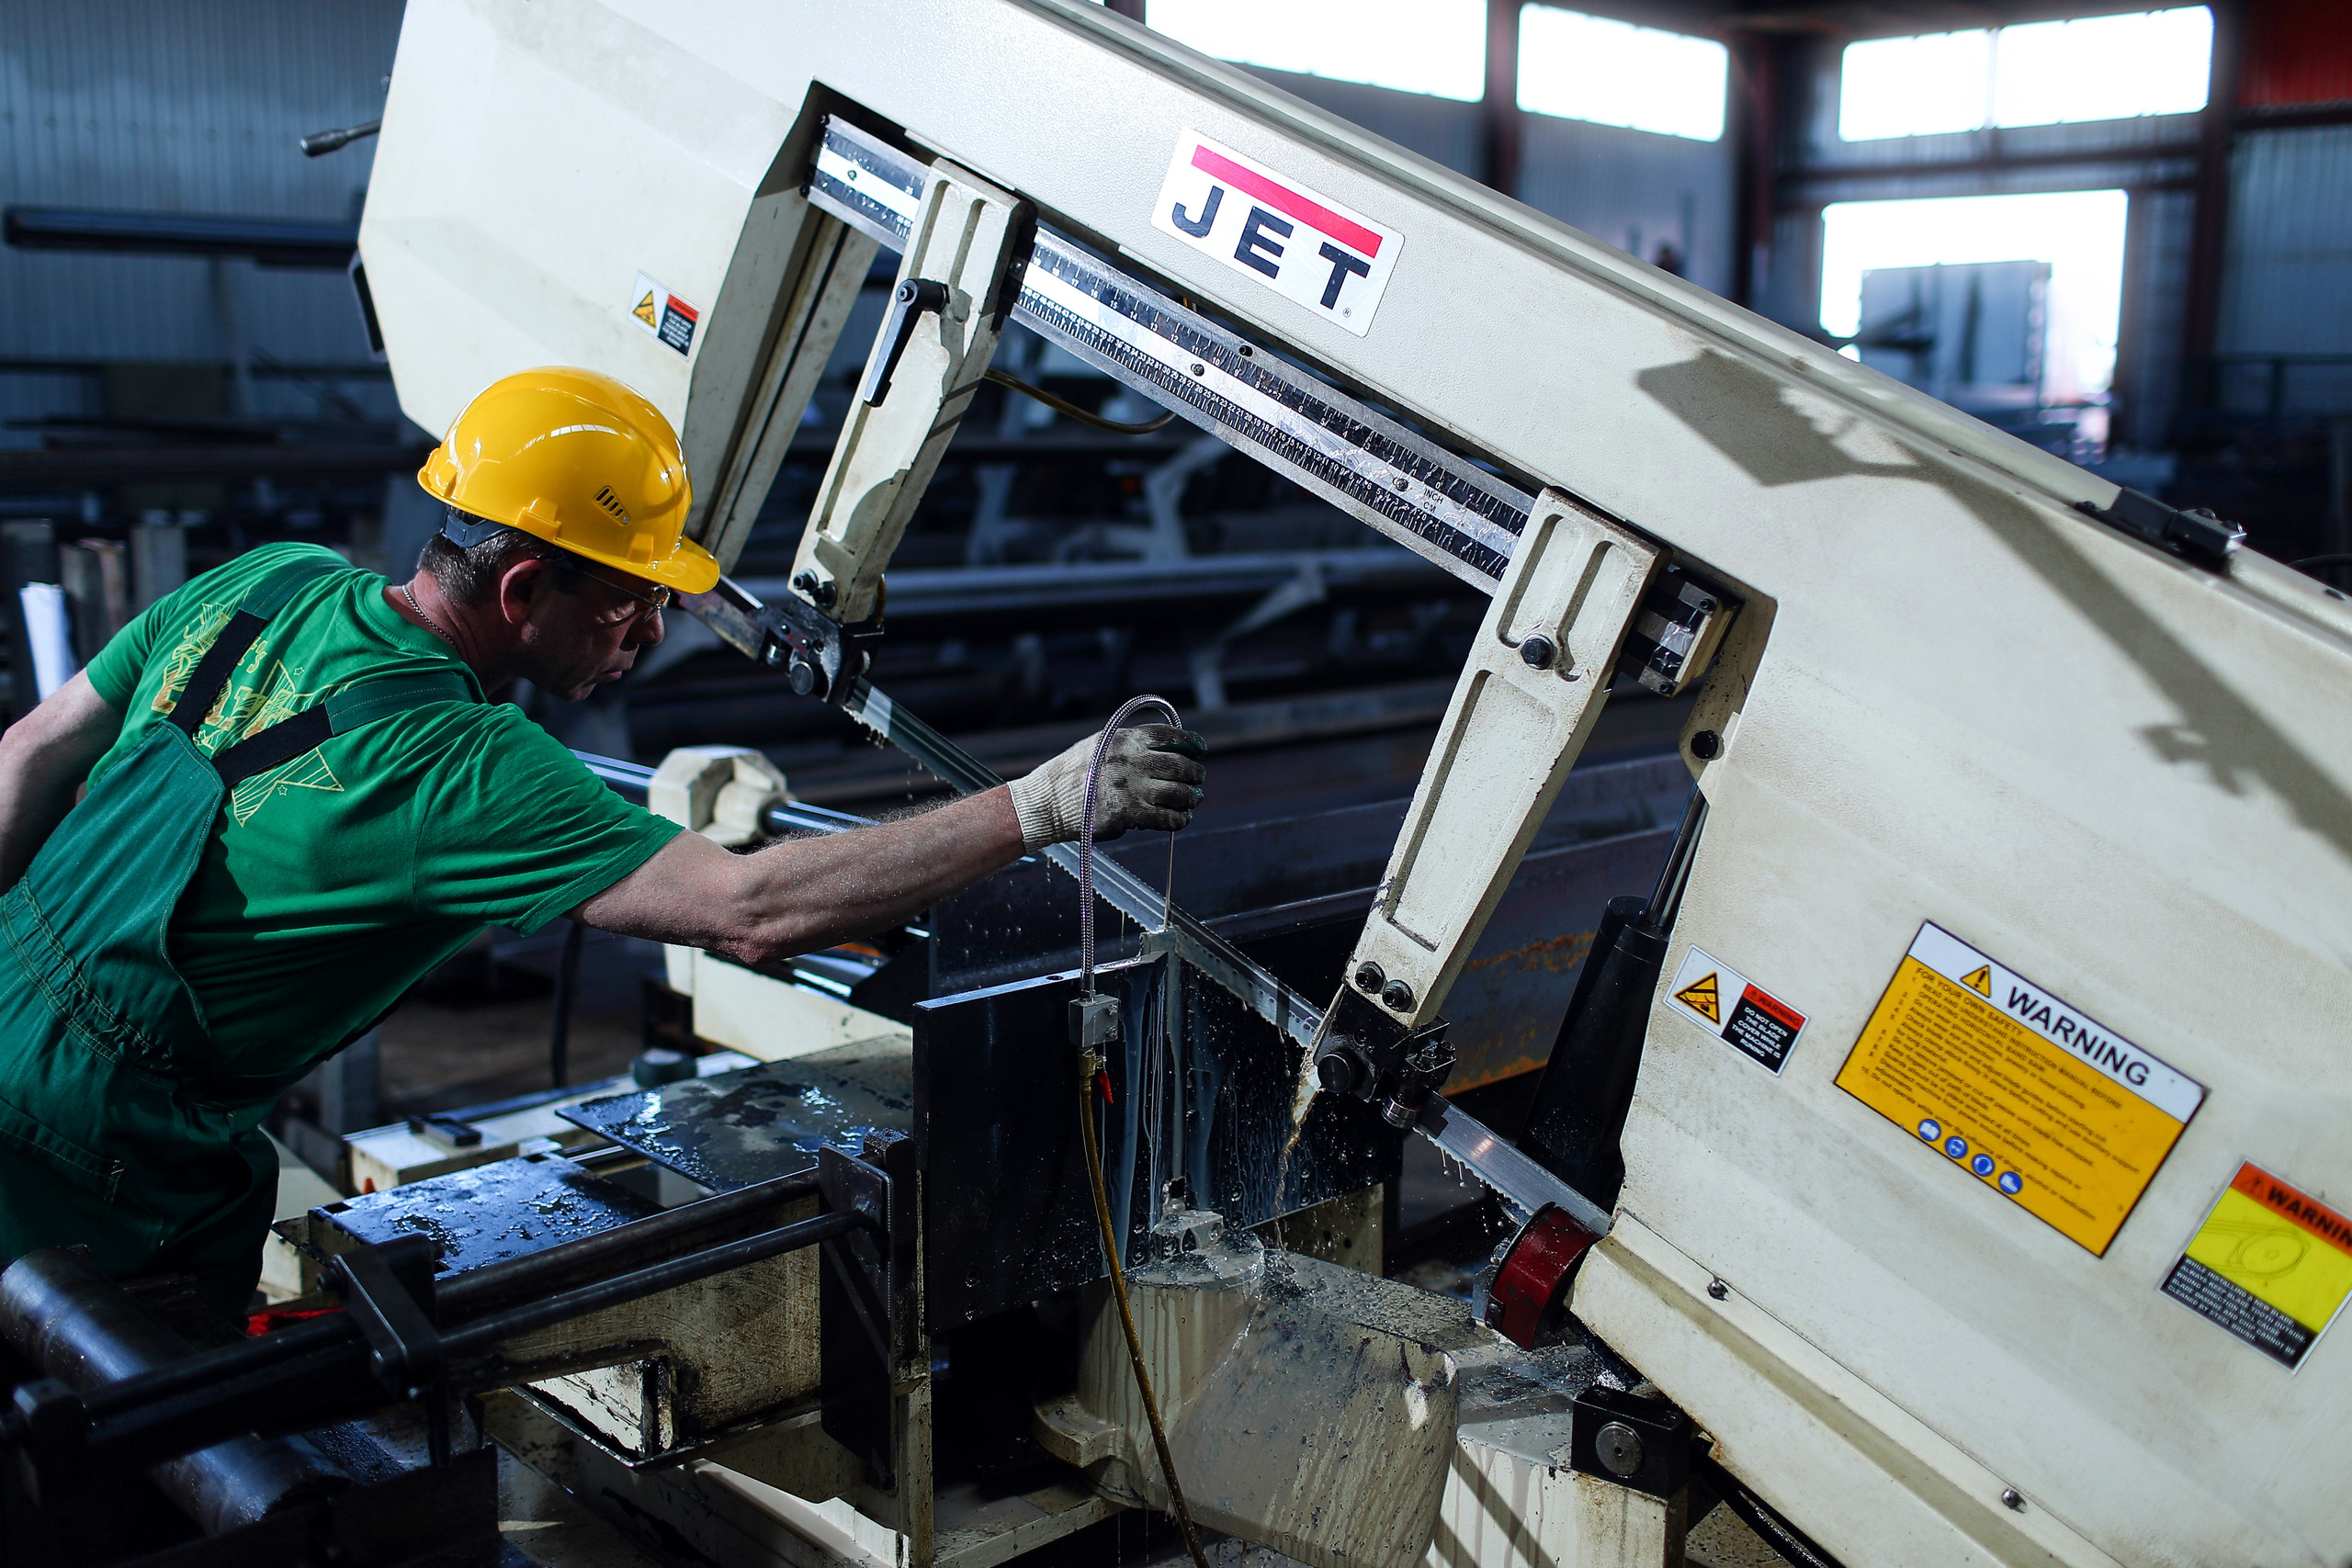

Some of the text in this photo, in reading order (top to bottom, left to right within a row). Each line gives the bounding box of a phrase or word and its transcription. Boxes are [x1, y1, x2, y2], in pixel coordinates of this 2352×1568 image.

[1171, 186, 1371, 310] JET
[1070, 277, 1079, 288] 17
[1090, 288, 1098, 299] 16
[1109, 299, 1118, 310] 15
[1128, 310, 1137, 321] 14
[1148, 321, 1159, 332] 13
[1170, 333, 1179, 343] 12
[1211, 355, 1220, 367] 10
[1254, 380, 1261, 389] 8
[1297, 404, 1304, 412] 6
[1186, 379, 1195, 389] 27
[1194, 384, 1204, 394] 26
[1203, 389, 1211, 399] 25
[1211, 393, 1219, 403] 24
[1219, 398, 1227, 408] 23
[1227, 402, 1236, 412] 22
[1235, 407, 1244, 417] 21
[1243, 412, 1252, 422] 20
[1295, 441, 1304, 451] 14
[1312, 451, 1321, 460] 12
[1421, 501, 1437, 513] CM
[1423, 488, 1444, 504] INCH
[1744, 1006, 1788, 1037] DO NOT OPEN
[1744, 1015, 1781, 1041] THE BLADE
[1915, 966, 1936, 983] FOR
[1936, 979, 1962, 999] YOUR
[1986, 1010, 2024, 1038] SAFETY
[1731, 1023, 1781, 1059] THE MACHINE IS
[1736, 1019, 1781, 1050] COVER WHILE
[2003, 984, 2153, 1089] WARNING
[2166, 1284, 2199, 1305] CLEANED
[2198, 1303, 2209, 1312] BY
[2209, 1309, 2231, 1325] STEEL
[2176, 1271, 2279, 1336] WRONG DIRECTION WILL CAUSE
[2180, 1264, 2208, 1283] ALWAYS
[2208, 1280, 2226, 1294] KEEP
[2226, 1292, 2249, 1308] BLADE
[2250, 1306, 2274, 1323] TOOTH
[2185, 1258, 2207, 1273] WHILE
[2207, 1270, 2247, 1297] INSTALLING
[2254, 1299, 2270, 1312] NEW
[2171, 1278, 2295, 1355] BLADE DAMAGE AND CHIP CANNOT BE
